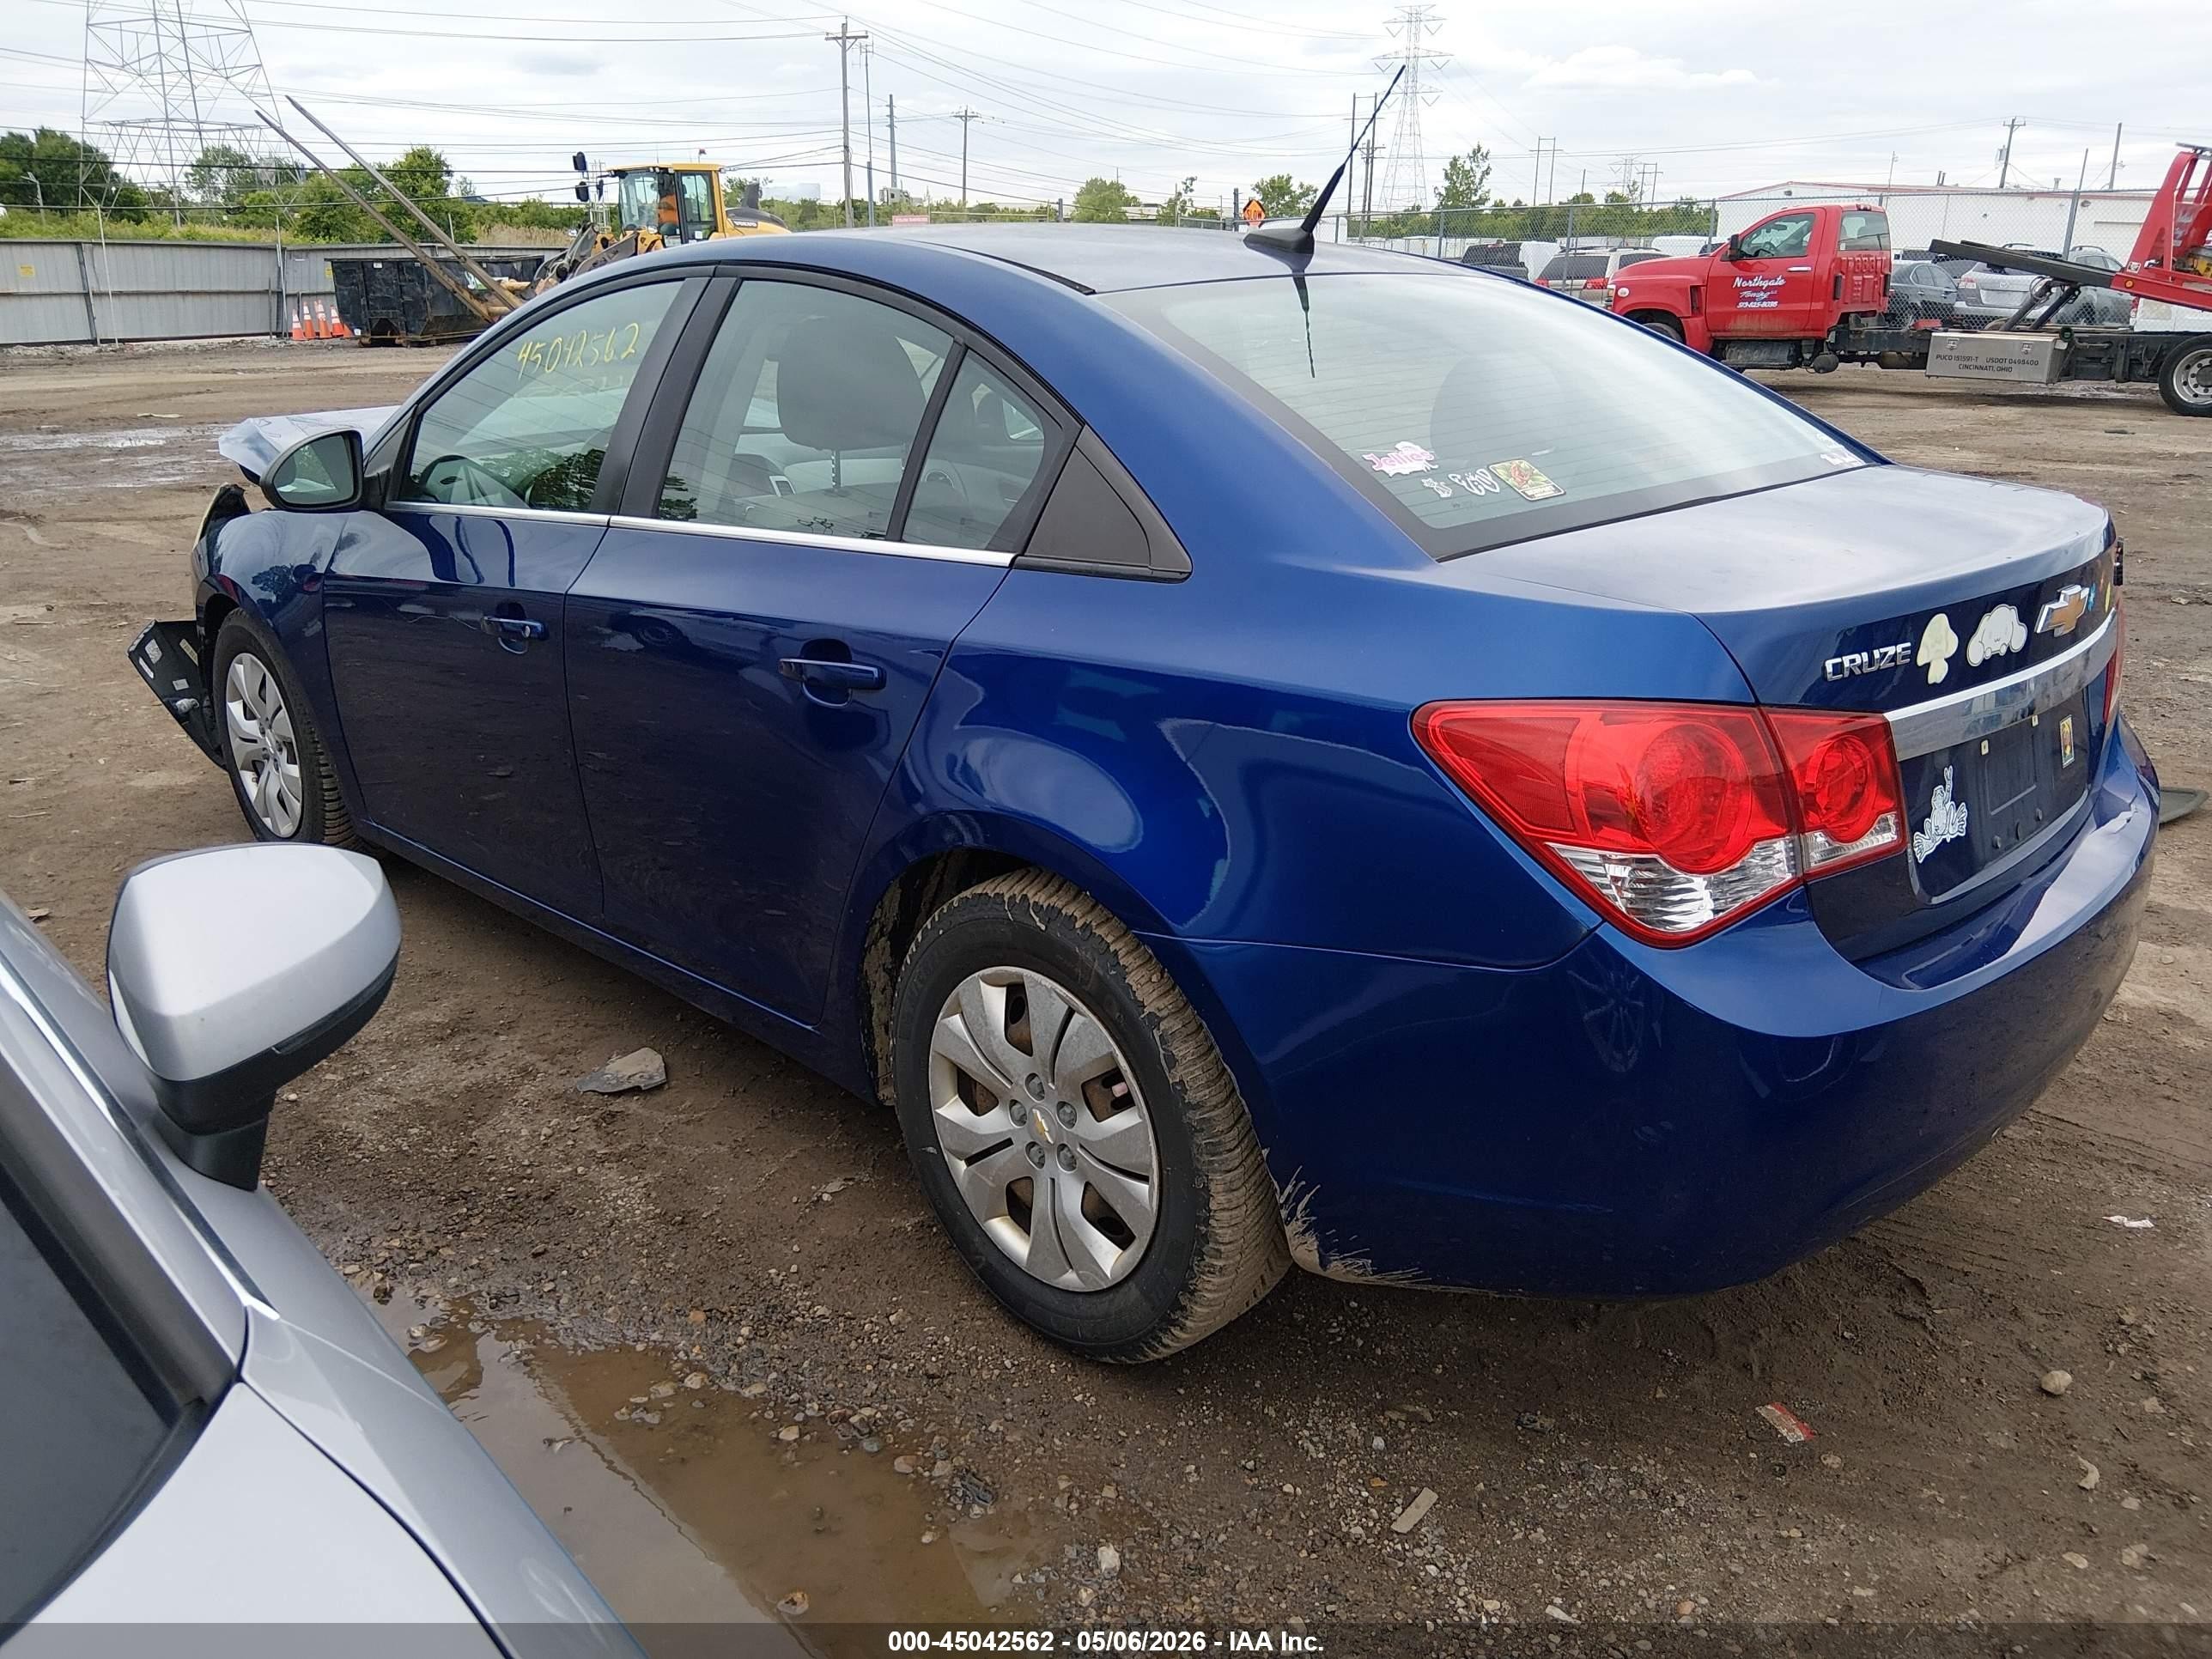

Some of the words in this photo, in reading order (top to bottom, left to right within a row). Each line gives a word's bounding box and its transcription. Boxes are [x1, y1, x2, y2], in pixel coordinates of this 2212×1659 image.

[1732, 275, 1786, 289] Northgate
[518, 323, 639, 380] 45042562
[1958, 363, 1996, 372] CINCINNATI,
[1826, 642, 1911, 682] CRUZE
